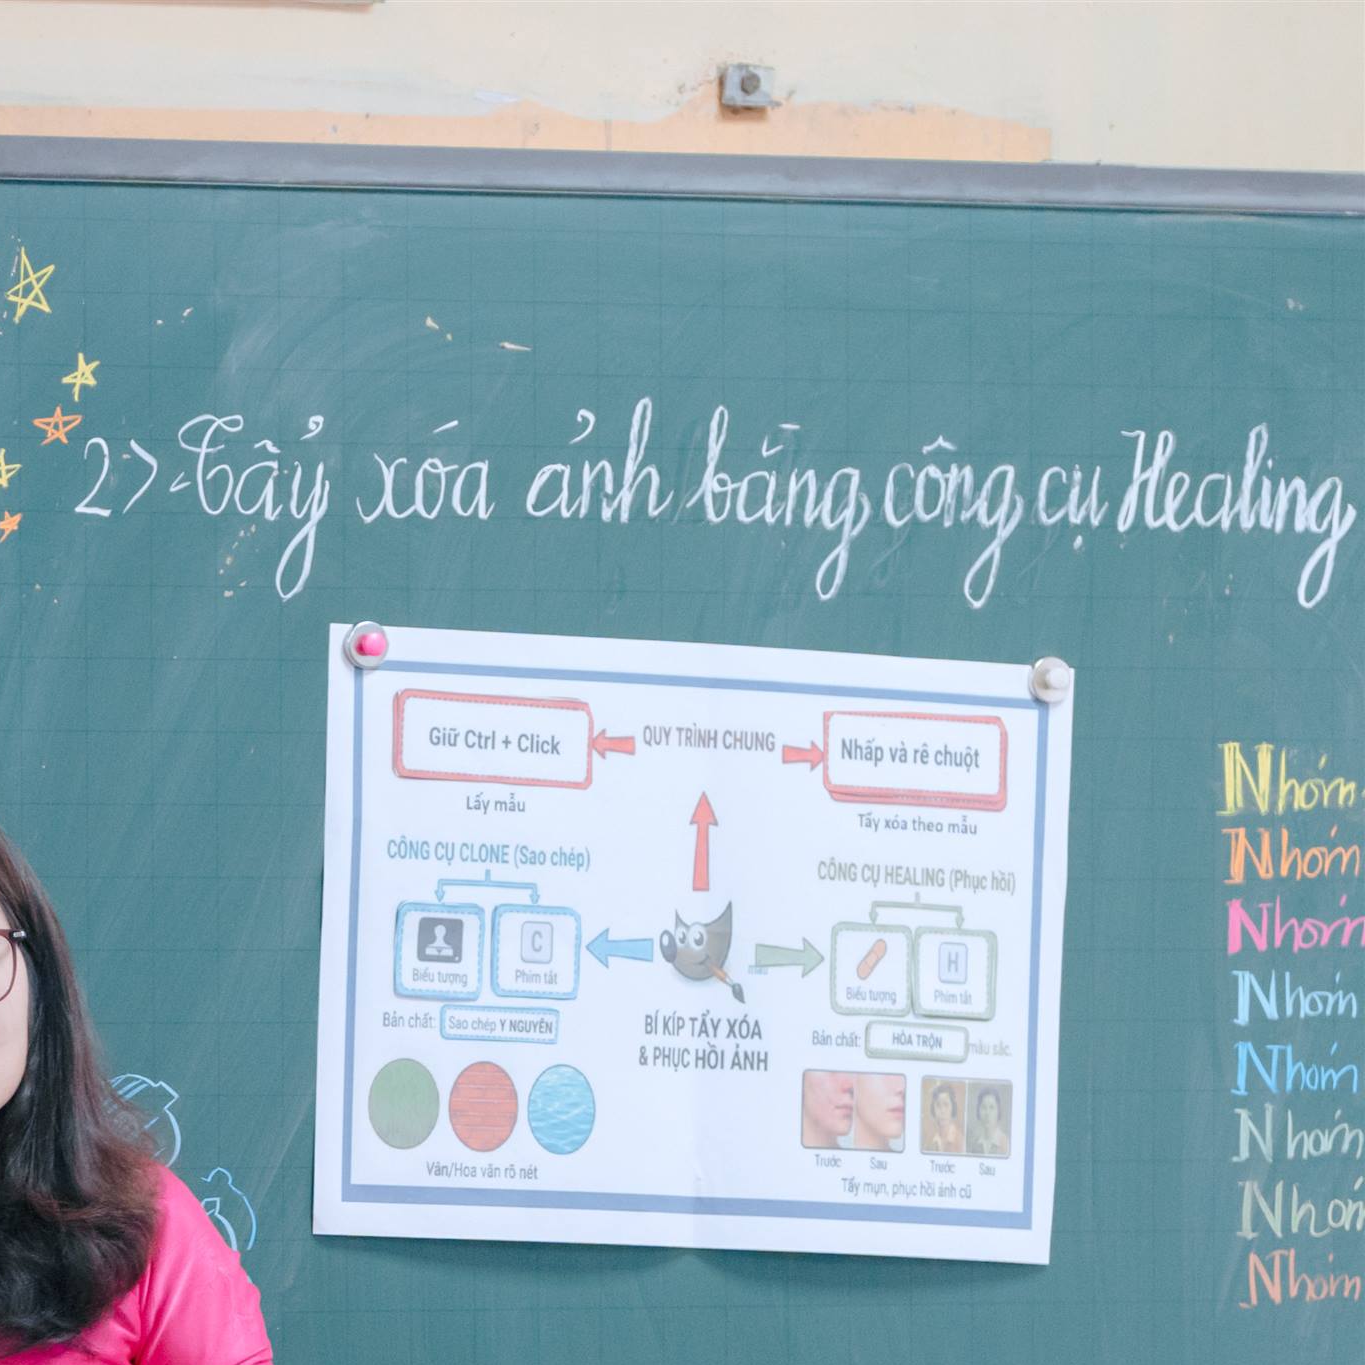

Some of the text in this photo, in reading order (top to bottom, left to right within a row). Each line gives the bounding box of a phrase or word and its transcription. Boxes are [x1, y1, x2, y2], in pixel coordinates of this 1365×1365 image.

[356, 418, 496, 523] xóa
[526, 396, 673, 524] ảnh
[883, 434, 1025, 609] công
[1037, 463, 1110, 551] cụ
[1116, 422, 1358, 609] Healing
[429, 727, 561, 755] Giữ Ctrl + Click
[643, 723, 776, 753] QUY TRÌNH CHUNG
[841, 738, 884, 767] Nhấp
[889, 741, 908, 764] và
[934, 744, 981, 773] chuột
[1216, 741, 1356, 816] Nhóm
[466, 792, 526, 814] Lấy mẫu
[884, 815, 908, 831] xóa
[912, 818, 943, 833] theo
[387, 835, 591, 872] CÔNG CỤ CLONE (Sao chép)
[1221, 825, 1360, 885] Nhóm
[817, 857, 1016, 895] CÔNG CỤ HEALING (Phục hồi)
[531, 930, 543, 952] C
[1226, 894, 1365, 954] Nhóm
[1232, 969, 1357, 1025] Nhóm
[382, 1012, 404, 1028] Bản
[448, 1015, 553, 1035] Sao chép Y NGUYÊN
[644, 1009, 762, 1040] BÍ KÍP TẨY XÓA
[639, 1042, 769, 1072] & PHỤC HỒI ẢNH
[1231, 1041, 1358, 1096] Nhóm
[1231, 1102, 1364, 1163] Nhóm
[520, 1164, 538, 1180] nét
[1239, 1247, 1361, 1309] Nhóm
